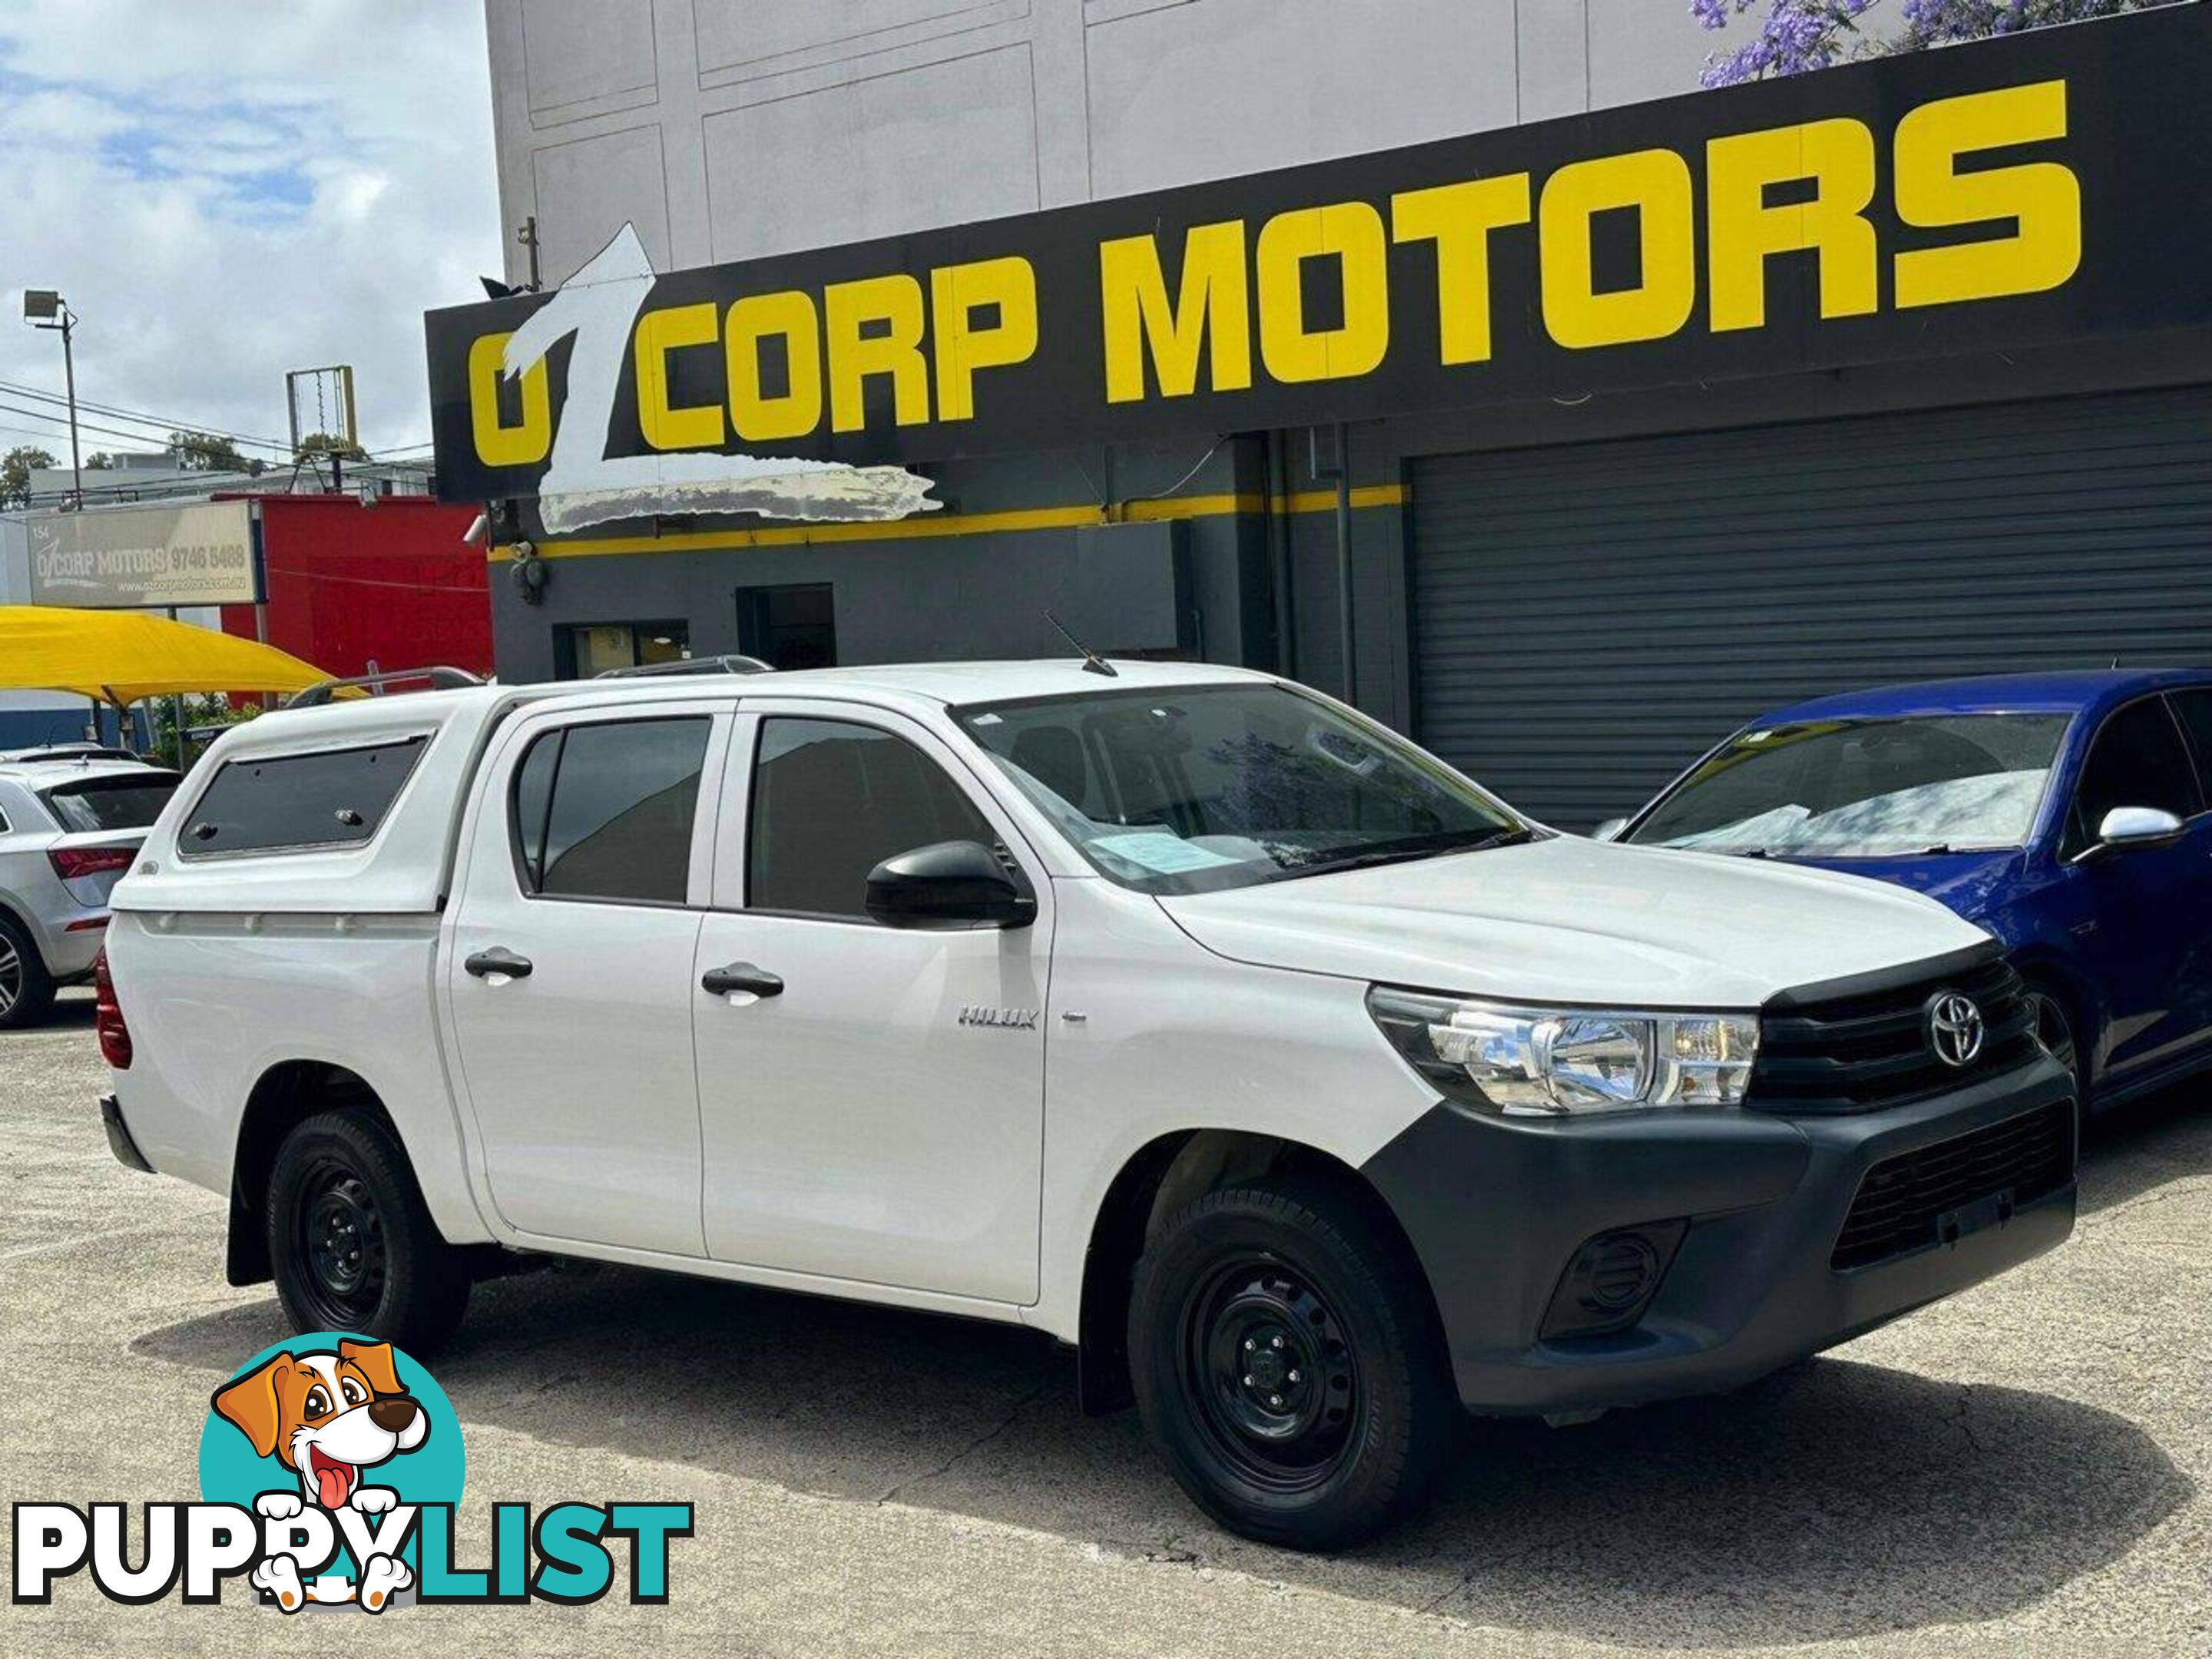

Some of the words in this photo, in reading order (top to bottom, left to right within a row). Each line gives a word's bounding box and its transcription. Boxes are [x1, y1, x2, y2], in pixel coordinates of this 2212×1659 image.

[468, 221, 1038, 534] OZCORP
[1100, 79, 2081, 403] MOTORS
[98, 548, 166, 575] MOTORS
[171, 546, 207, 570] 9746
[959, 1006, 1039, 1031] HILUX
